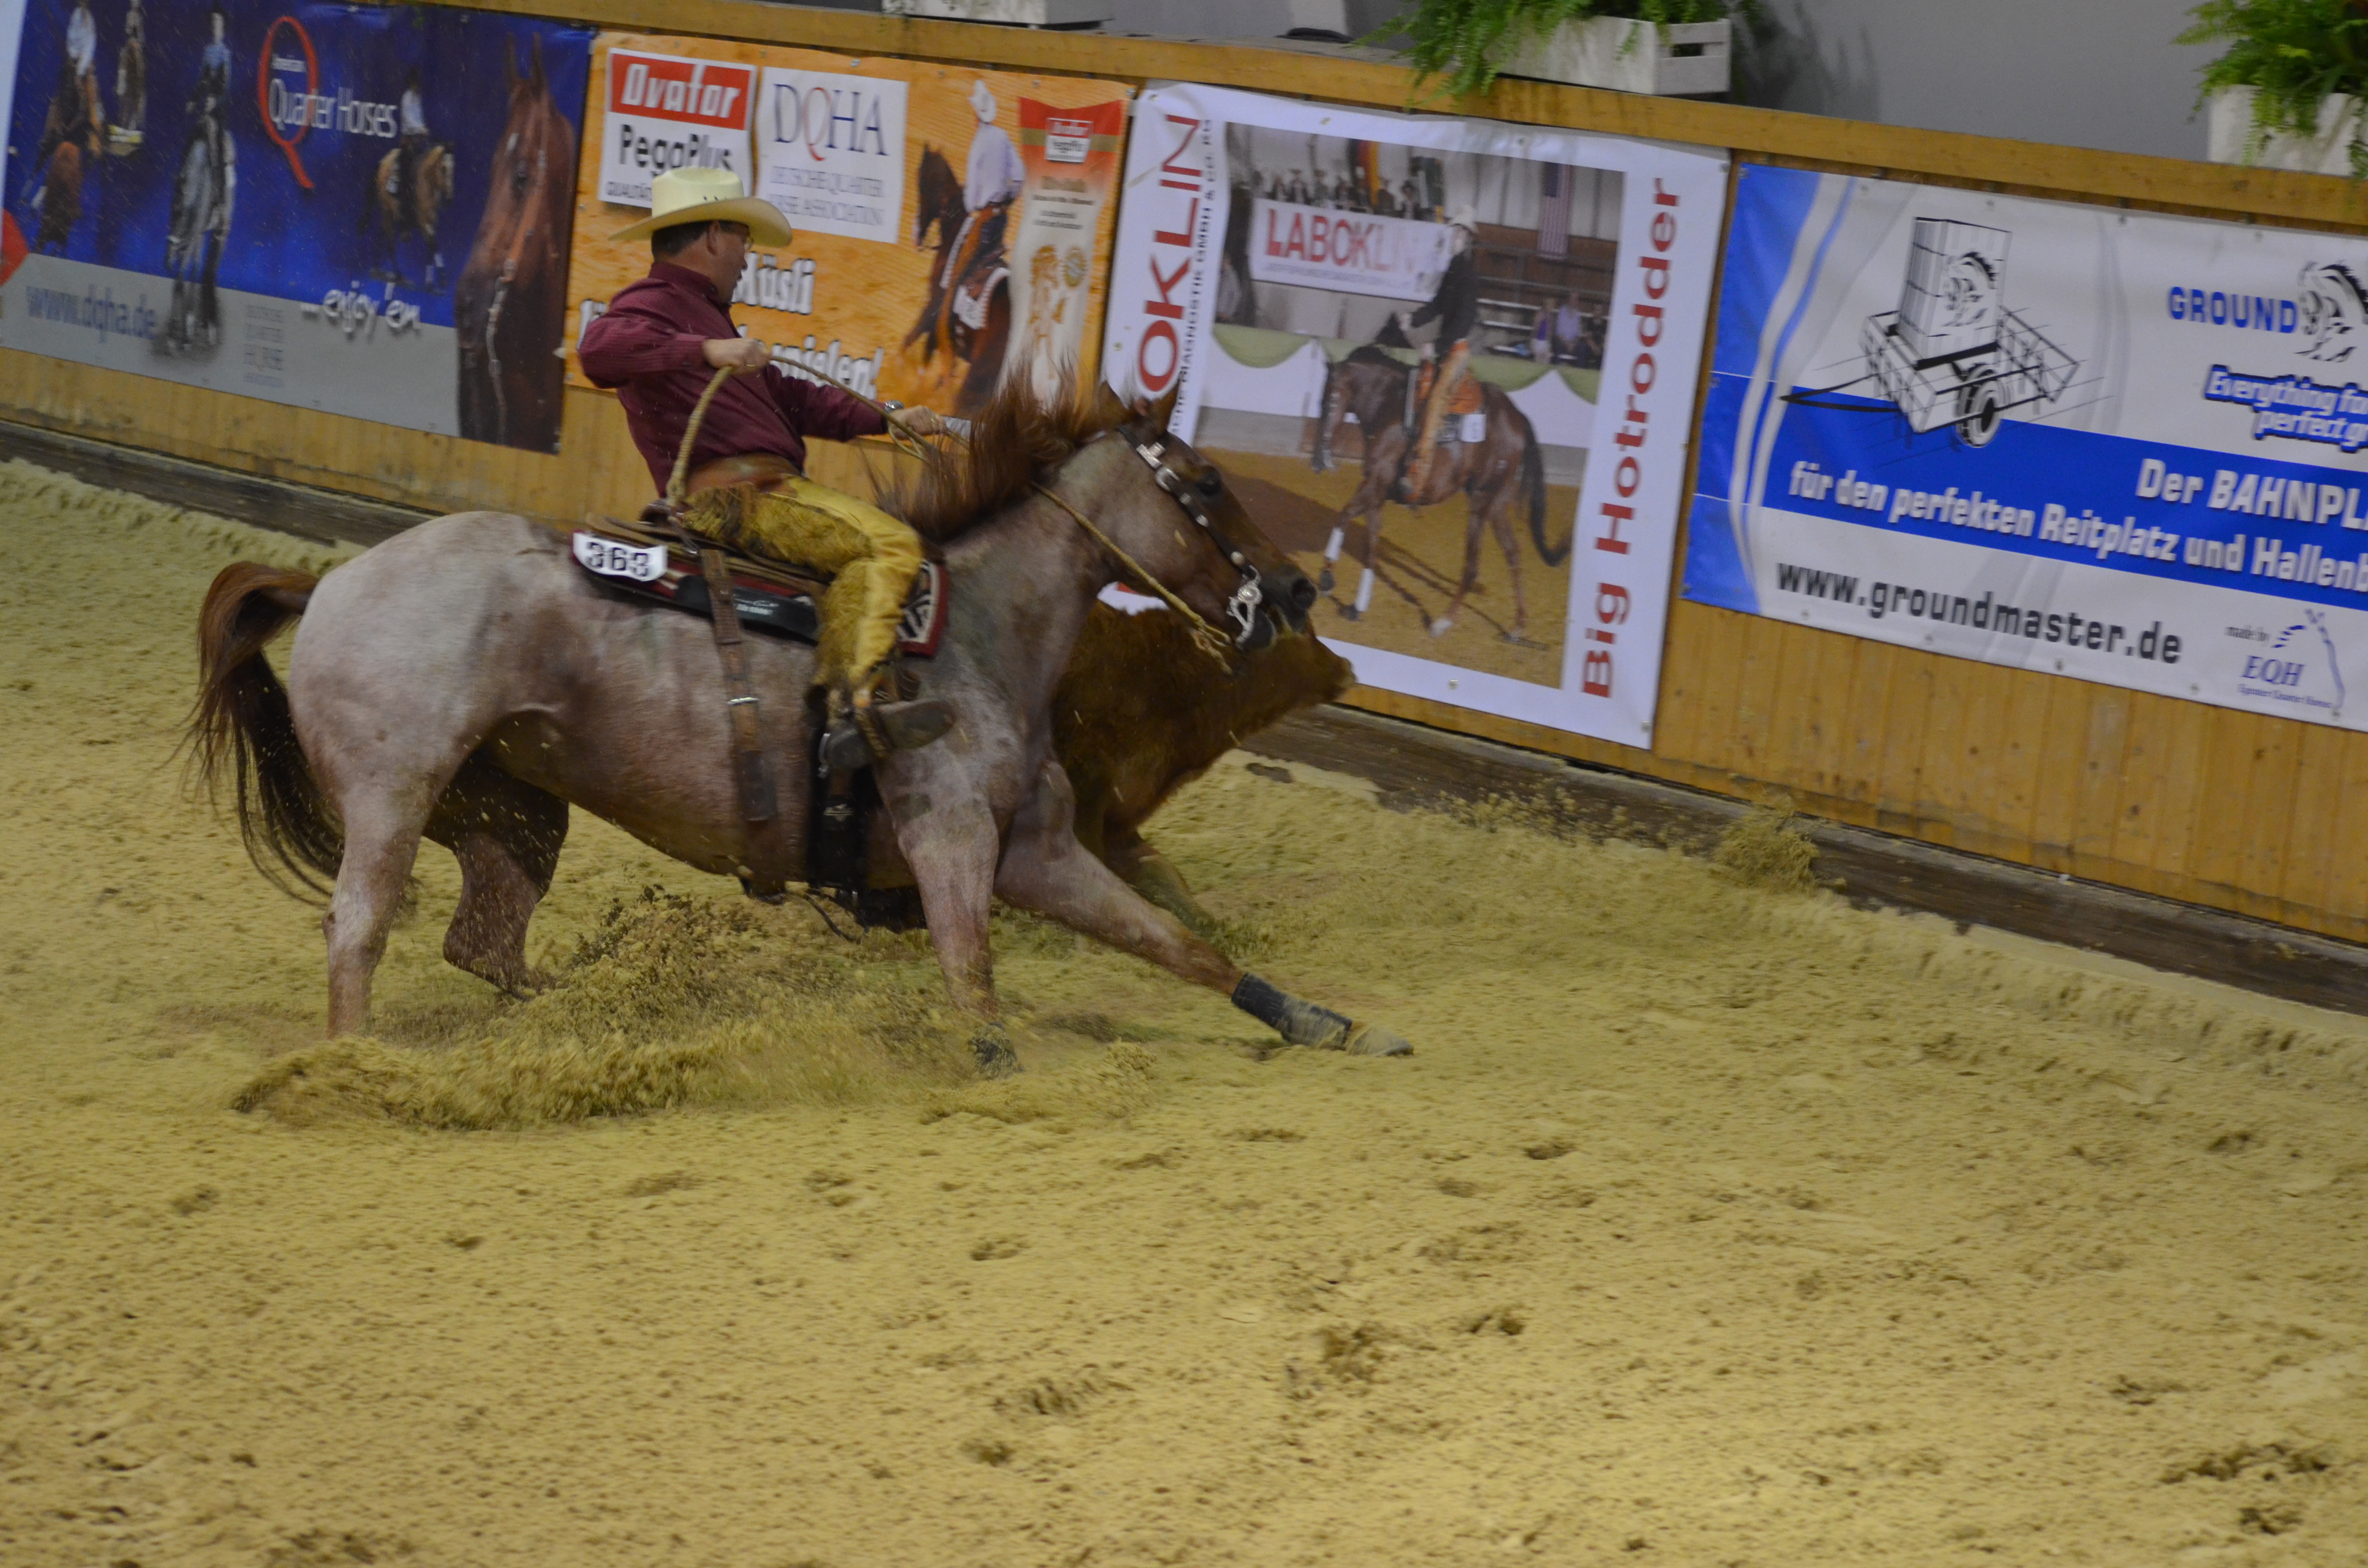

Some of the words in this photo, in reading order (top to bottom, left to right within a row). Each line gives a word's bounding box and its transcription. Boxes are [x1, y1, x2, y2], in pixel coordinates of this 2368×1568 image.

[269, 78, 337, 131] Quarter
[336, 87, 397, 138] Horses
[621, 61, 741, 118] Ovator
[773, 83, 889, 161] DQHA
[2170, 286, 2299, 333] GROUND
[1595, 177, 1679, 555] Hotrodder
[2208, 367, 2339, 417] Everything
[2257, 409, 2347, 438] perfect
[1788, 461, 1834, 501] für
[1835, 470, 1889, 511] den
[1887, 487, 2035, 538] perfekten
[2037, 502, 2181, 560] Reitplatz
[2183, 534, 2246, 572] und
[2135, 458, 2204, 504] Der
[2207, 469, 2368, 530] BAHNPL
[1581, 582, 1631, 698] Big
[1776, 563, 2183, 664] www.groundmaster.de
[2240, 655, 2306, 687] EQH
